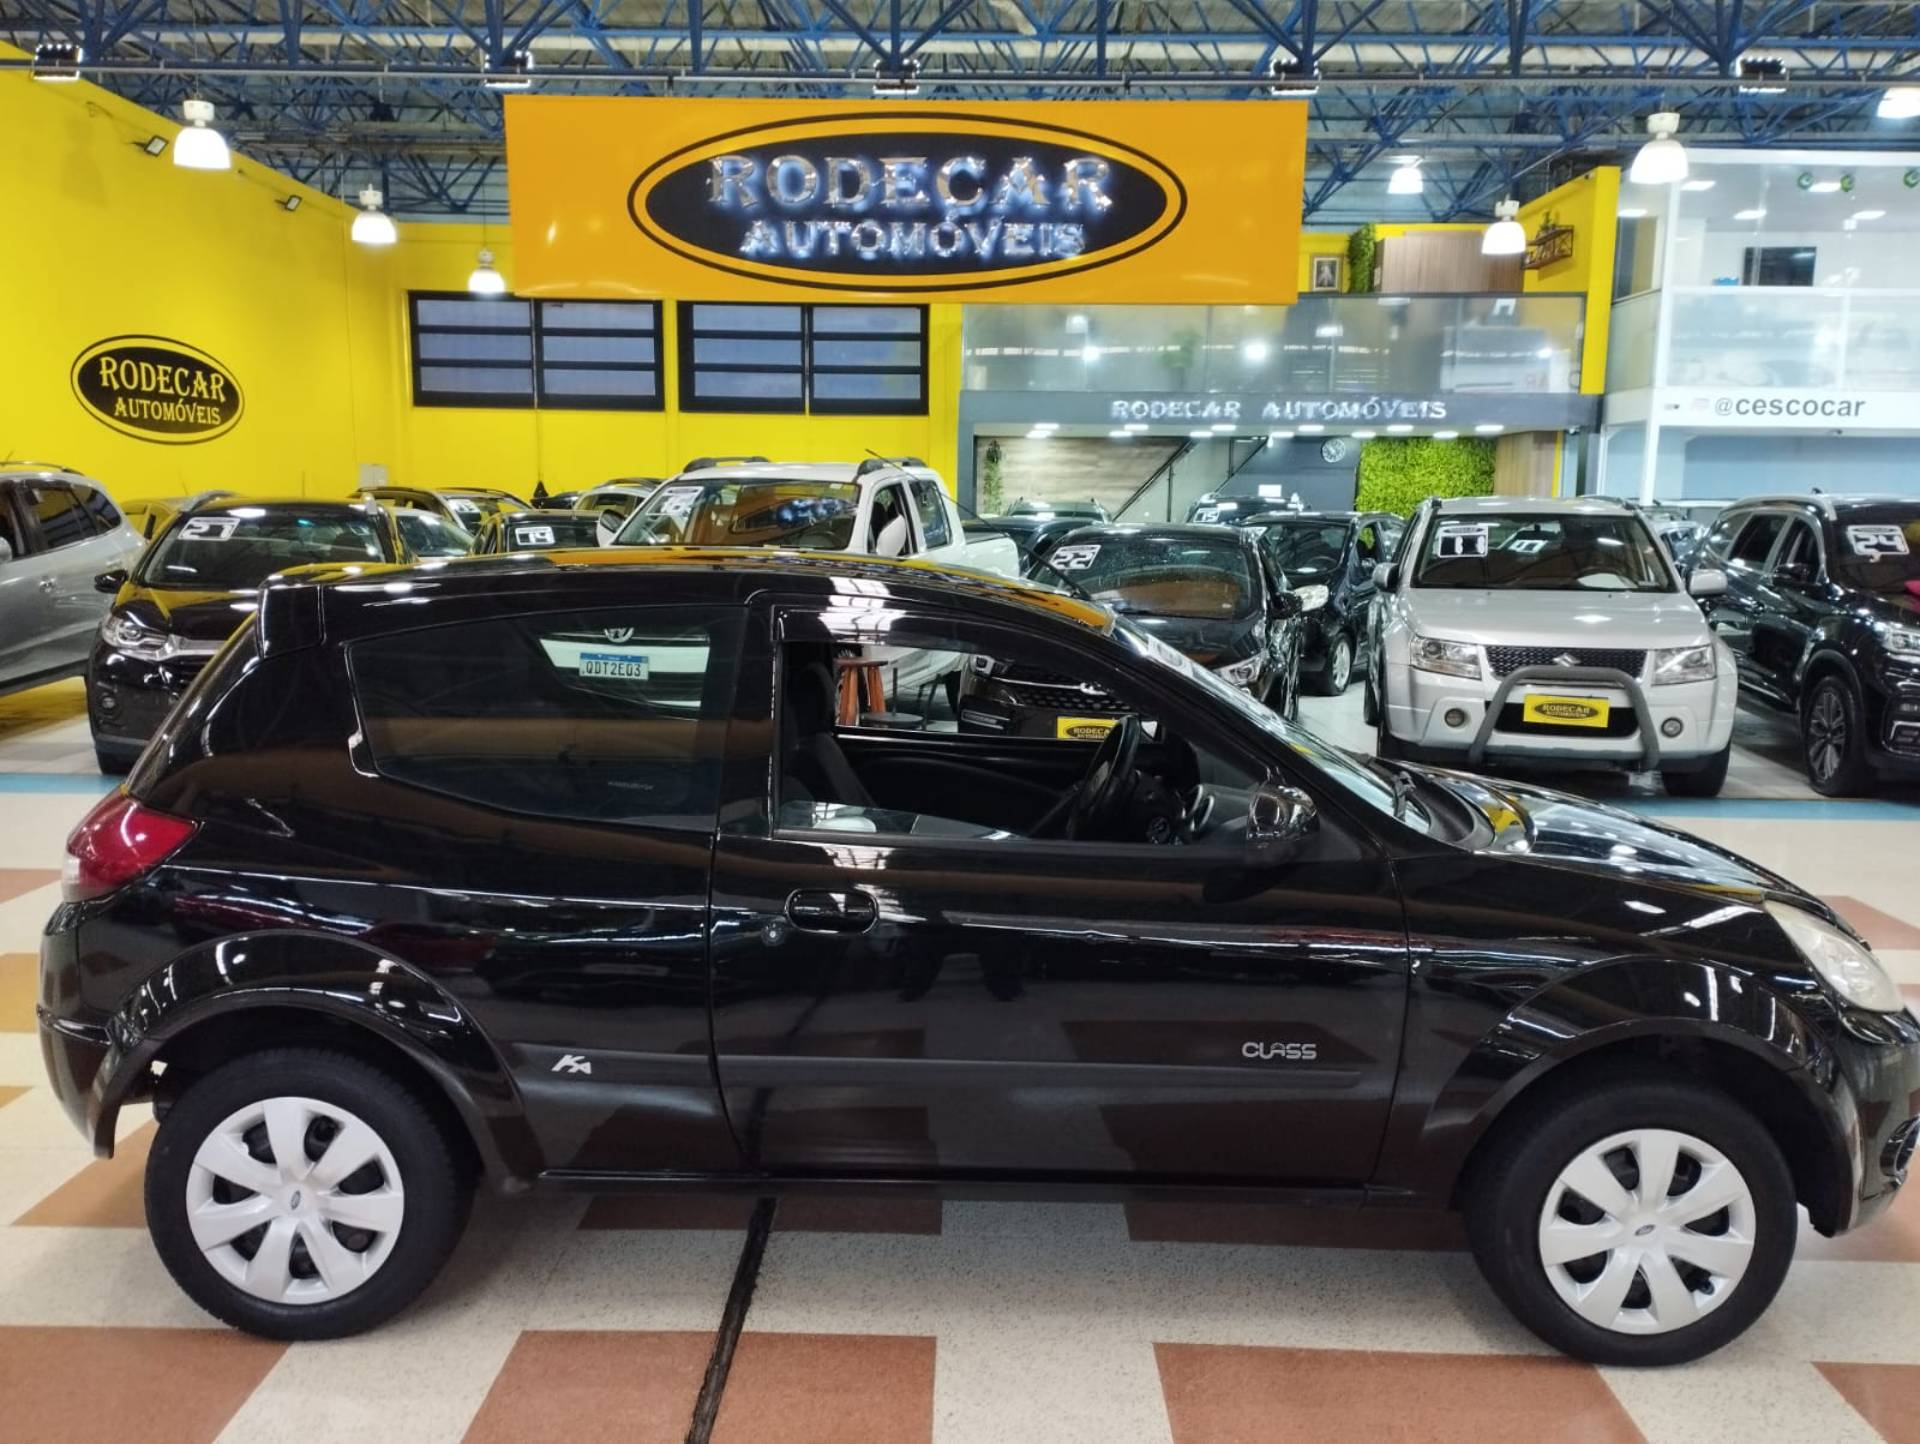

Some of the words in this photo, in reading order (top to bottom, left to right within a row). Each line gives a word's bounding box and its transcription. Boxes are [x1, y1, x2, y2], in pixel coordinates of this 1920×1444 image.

[708, 155, 1113, 210] RODECAR
[739, 208, 1086, 257] AUTOMÓVEIS
[99, 356, 226, 403] RODECAR
[114, 397, 222, 425] AUTOMÓVEIS
[1111, 400, 1241, 419] RODECAR
[1262, 396, 1448, 420] AUTOMÓVEIS
[1714, 397, 1866, 417] @cescocar
[1854, 534, 1906, 553] 24
[1052, 551, 1093, 569] 22
[586, 660, 641, 677] QDT2E03
[1241, 1041, 1317, 1060] CLASS
